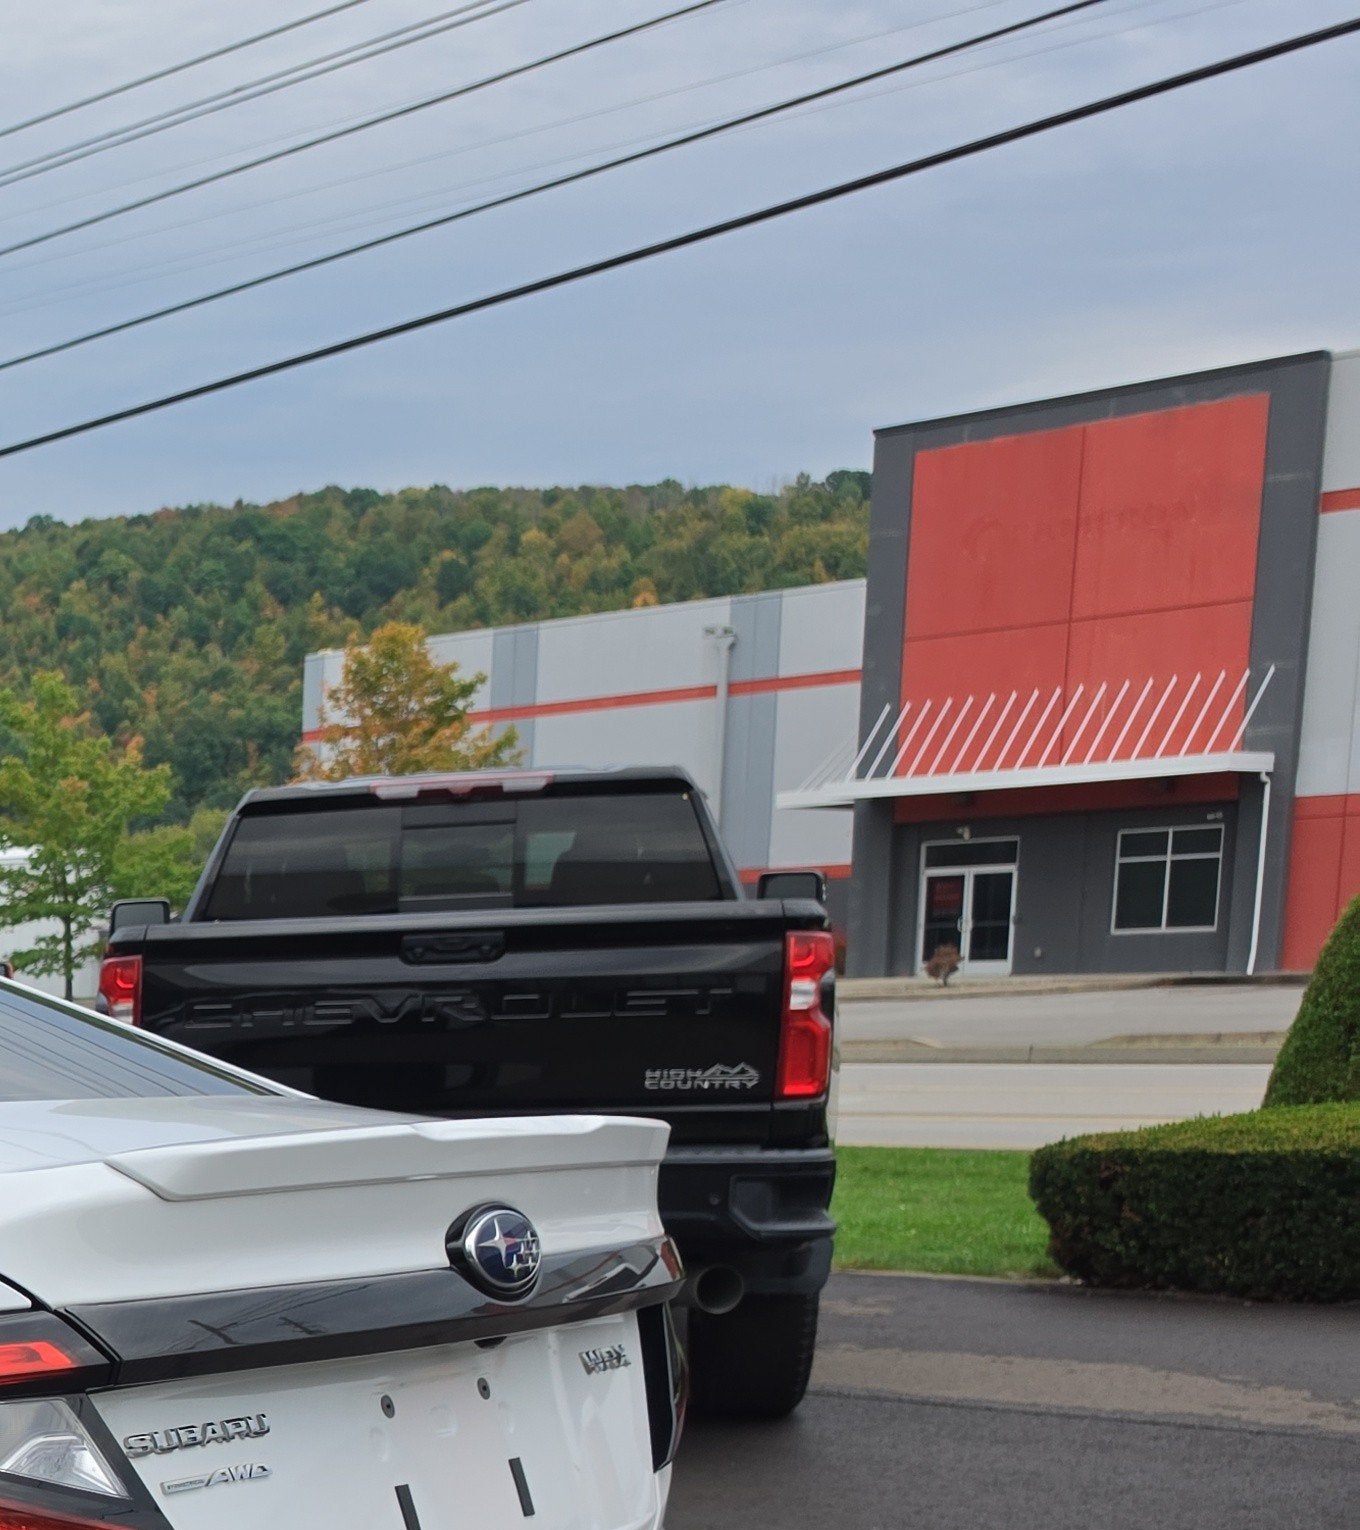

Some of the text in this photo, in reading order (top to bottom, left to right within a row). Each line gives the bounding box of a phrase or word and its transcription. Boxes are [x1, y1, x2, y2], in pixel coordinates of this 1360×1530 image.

[183, 989, 734, 1029] CHEVROLET
[644, 1079, 759, 1090] COUNTRY
[645, 1068, 702, 1081] HIGH
[579, 1345, 631, 1375] WRX
[123, 1413, 272, 1458] SUBARU
[205, 1462, 273, 1488] AWD
